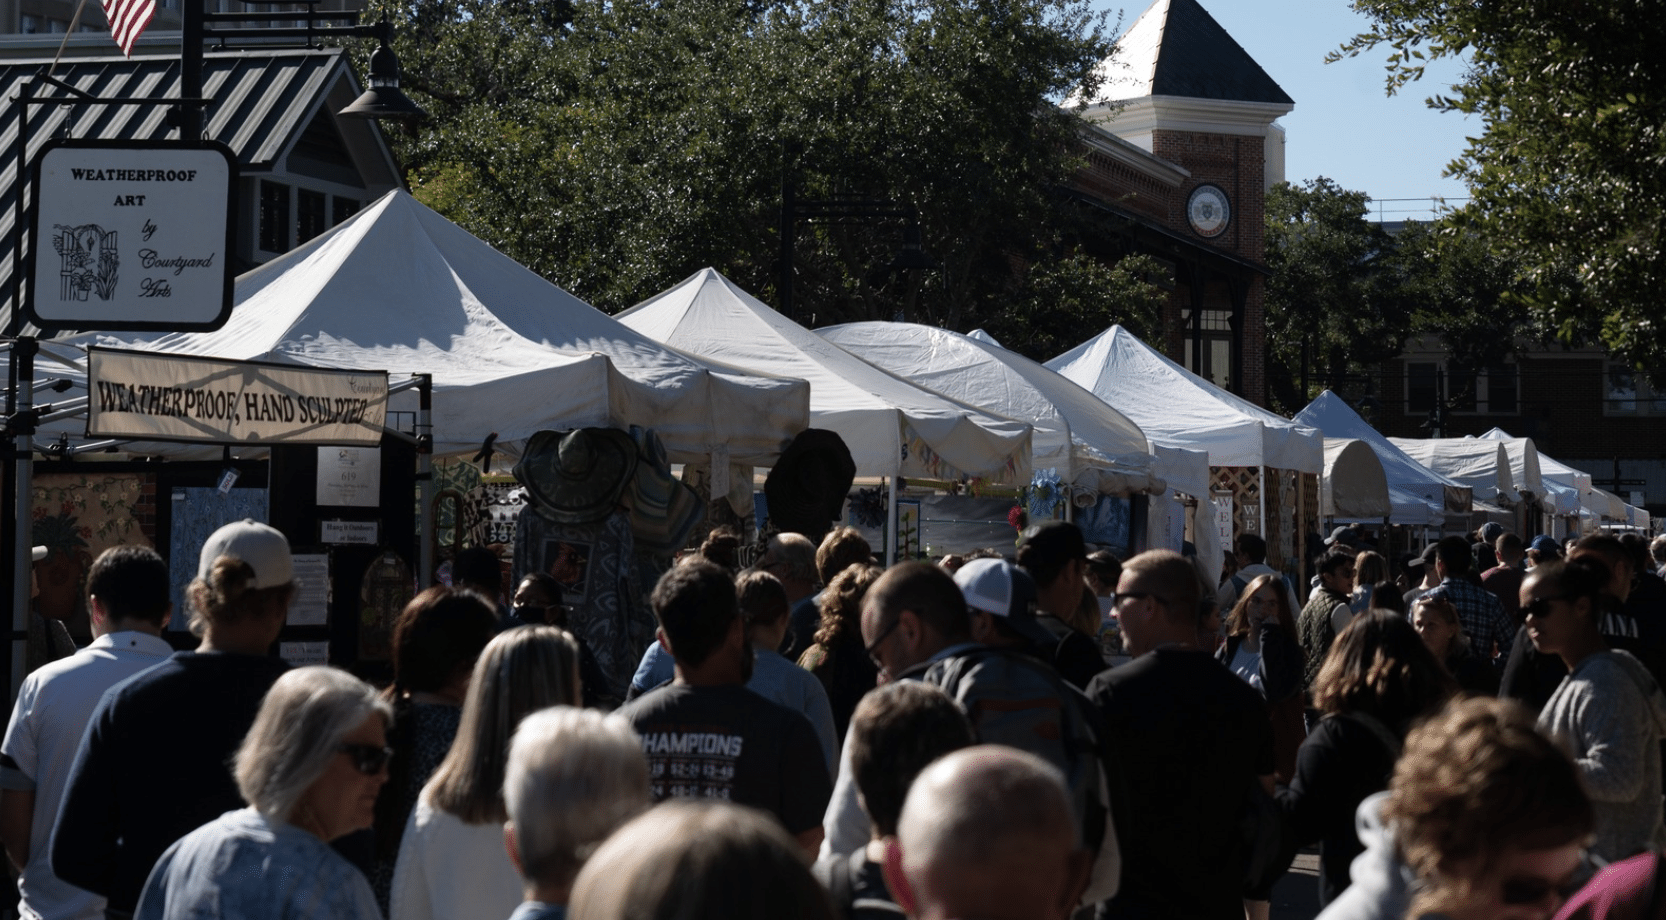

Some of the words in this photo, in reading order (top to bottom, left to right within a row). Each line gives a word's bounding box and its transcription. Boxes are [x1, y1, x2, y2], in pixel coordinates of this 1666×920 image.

[71, 168, 197, 182] WEATHERPROOF
[113, 195, 146, 206] ART
[142, 218, 157, 241] by
[138, 248, 215, 275] Courtyard
[138, 278, 172, 297] Arts
[97, 380, 240, 426] WEATHERPROOF,
[245, 392, 296, 423] HAND
[298, 397, 368, 425] SCULPTED
[1597, 611, 1640, 639] ANA
[641, 732, 743, 757] HAMPIONS
